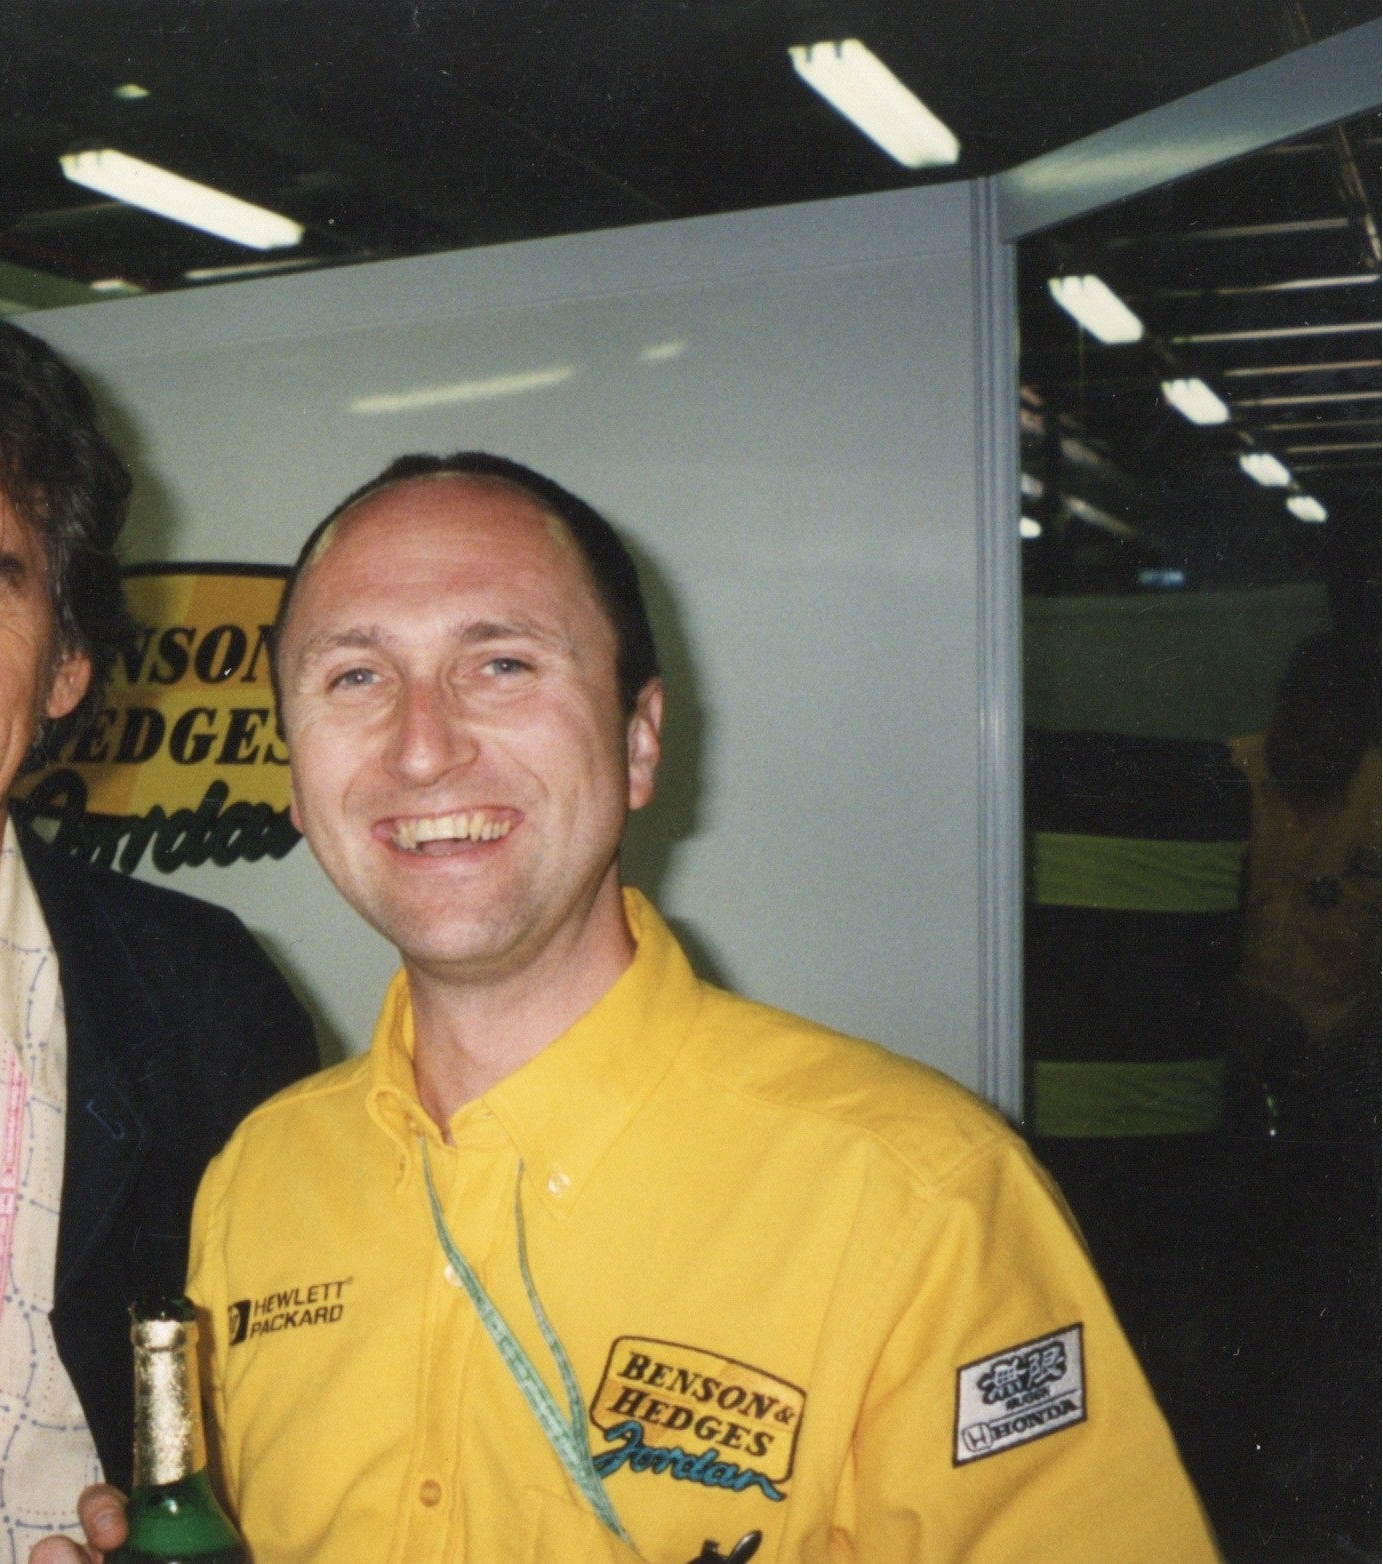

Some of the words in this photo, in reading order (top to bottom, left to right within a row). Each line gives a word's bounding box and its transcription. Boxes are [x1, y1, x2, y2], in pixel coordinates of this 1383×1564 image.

[250, 1304, 344, 1339] PACKARD
[254, 1280, 345, 1317] HEWLETT
[617, 1351, 780, 1420] BENSON
[609, 1386, 774, 1457] HEDGES
[991, 1398, 1078, 1440] HONDA
[593, 1419, 787, 1502] Jordan
